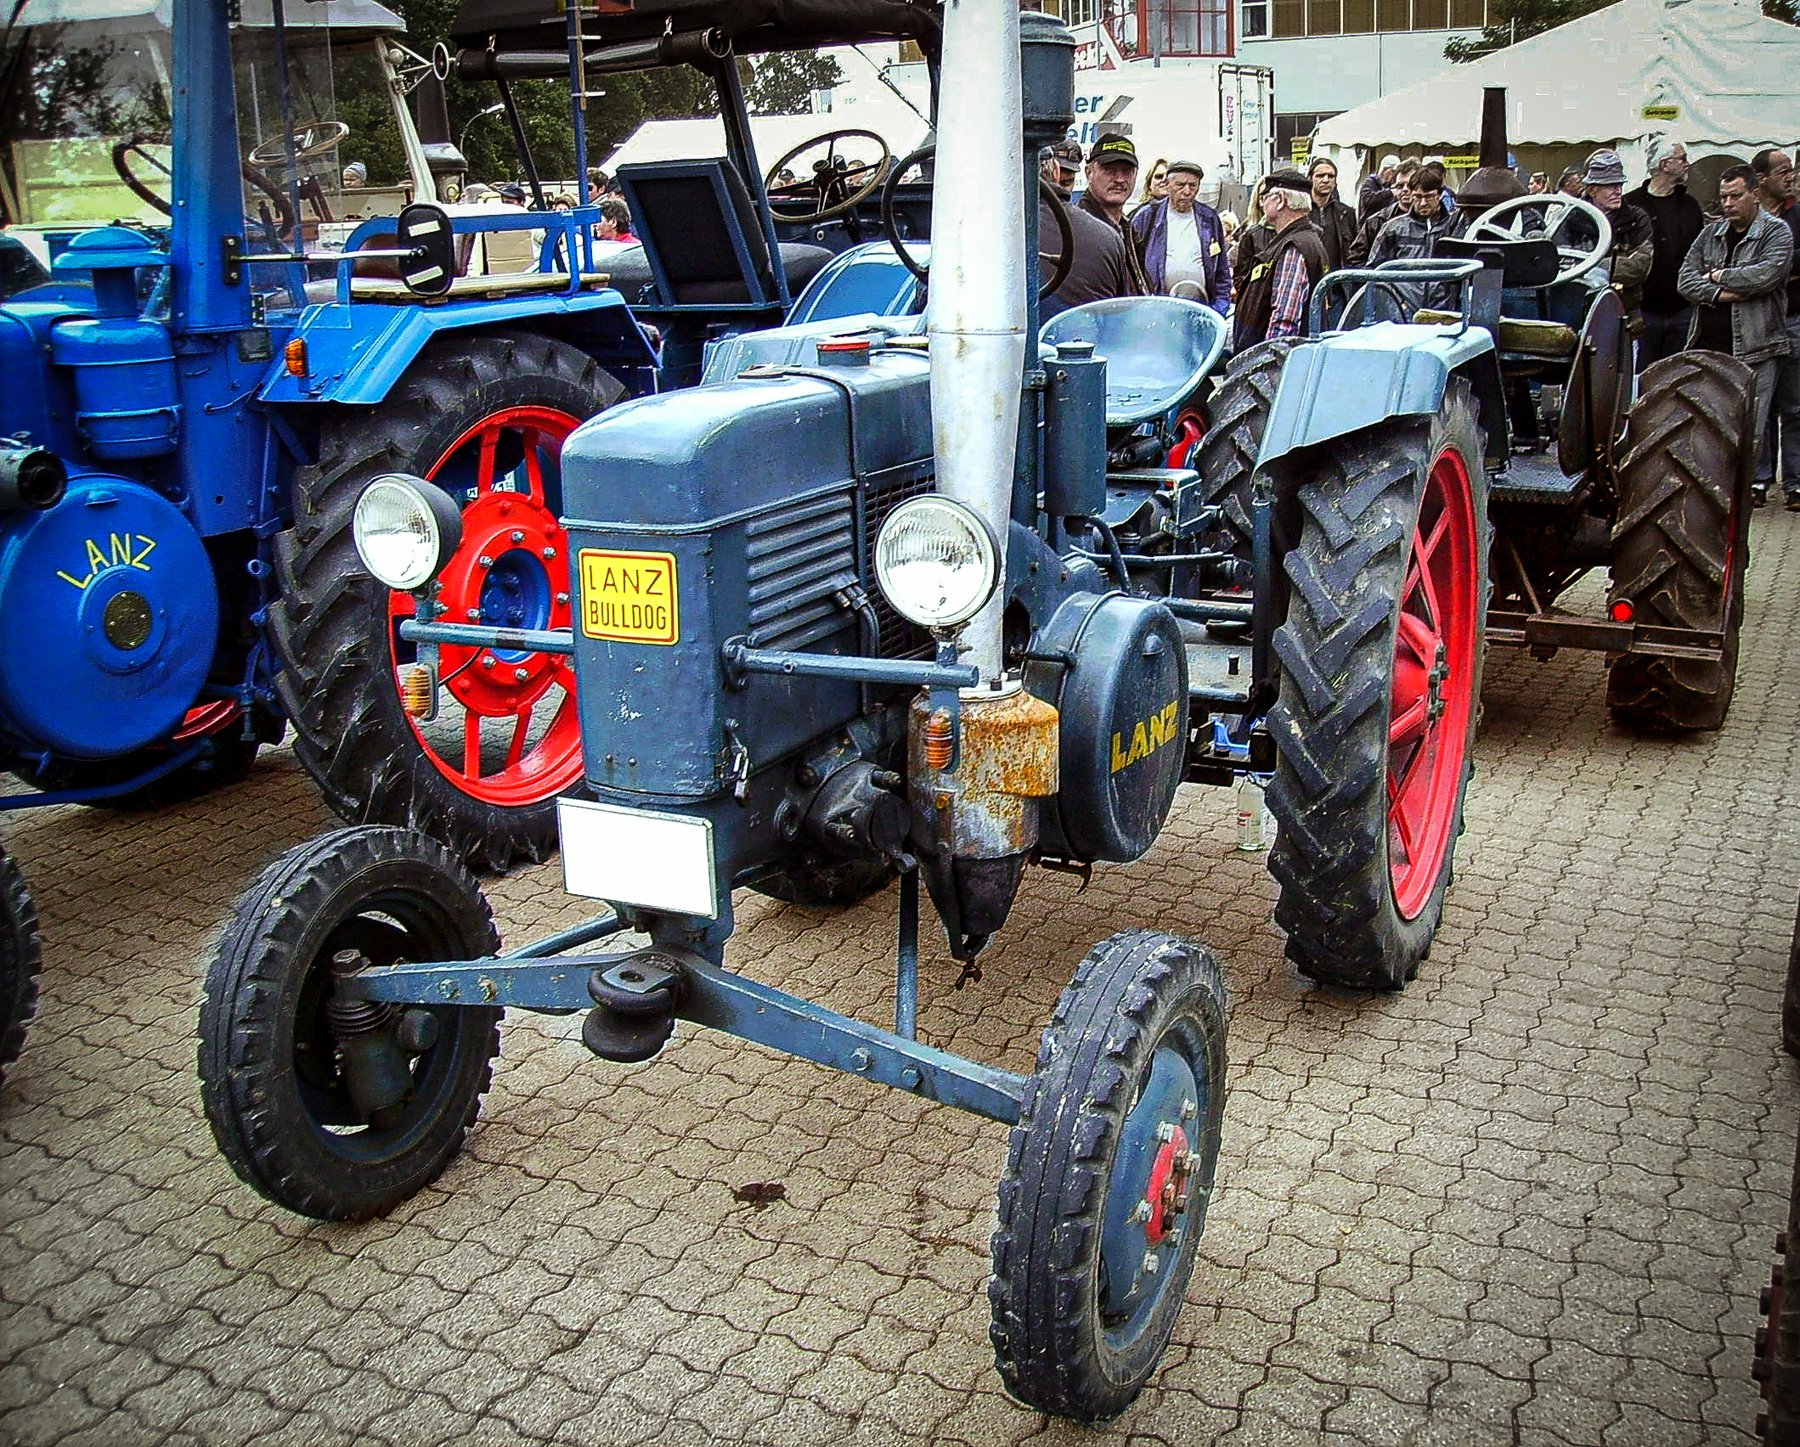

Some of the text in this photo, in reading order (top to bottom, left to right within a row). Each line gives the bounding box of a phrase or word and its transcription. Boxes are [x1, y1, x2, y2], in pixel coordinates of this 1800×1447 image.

[56, 532, 158, 590] LANZ
[589, 565, 663, 596] LANZ
[590, 600, 667, 630] BULLDOG
[1110, 700, 1179, 774] LANZ
